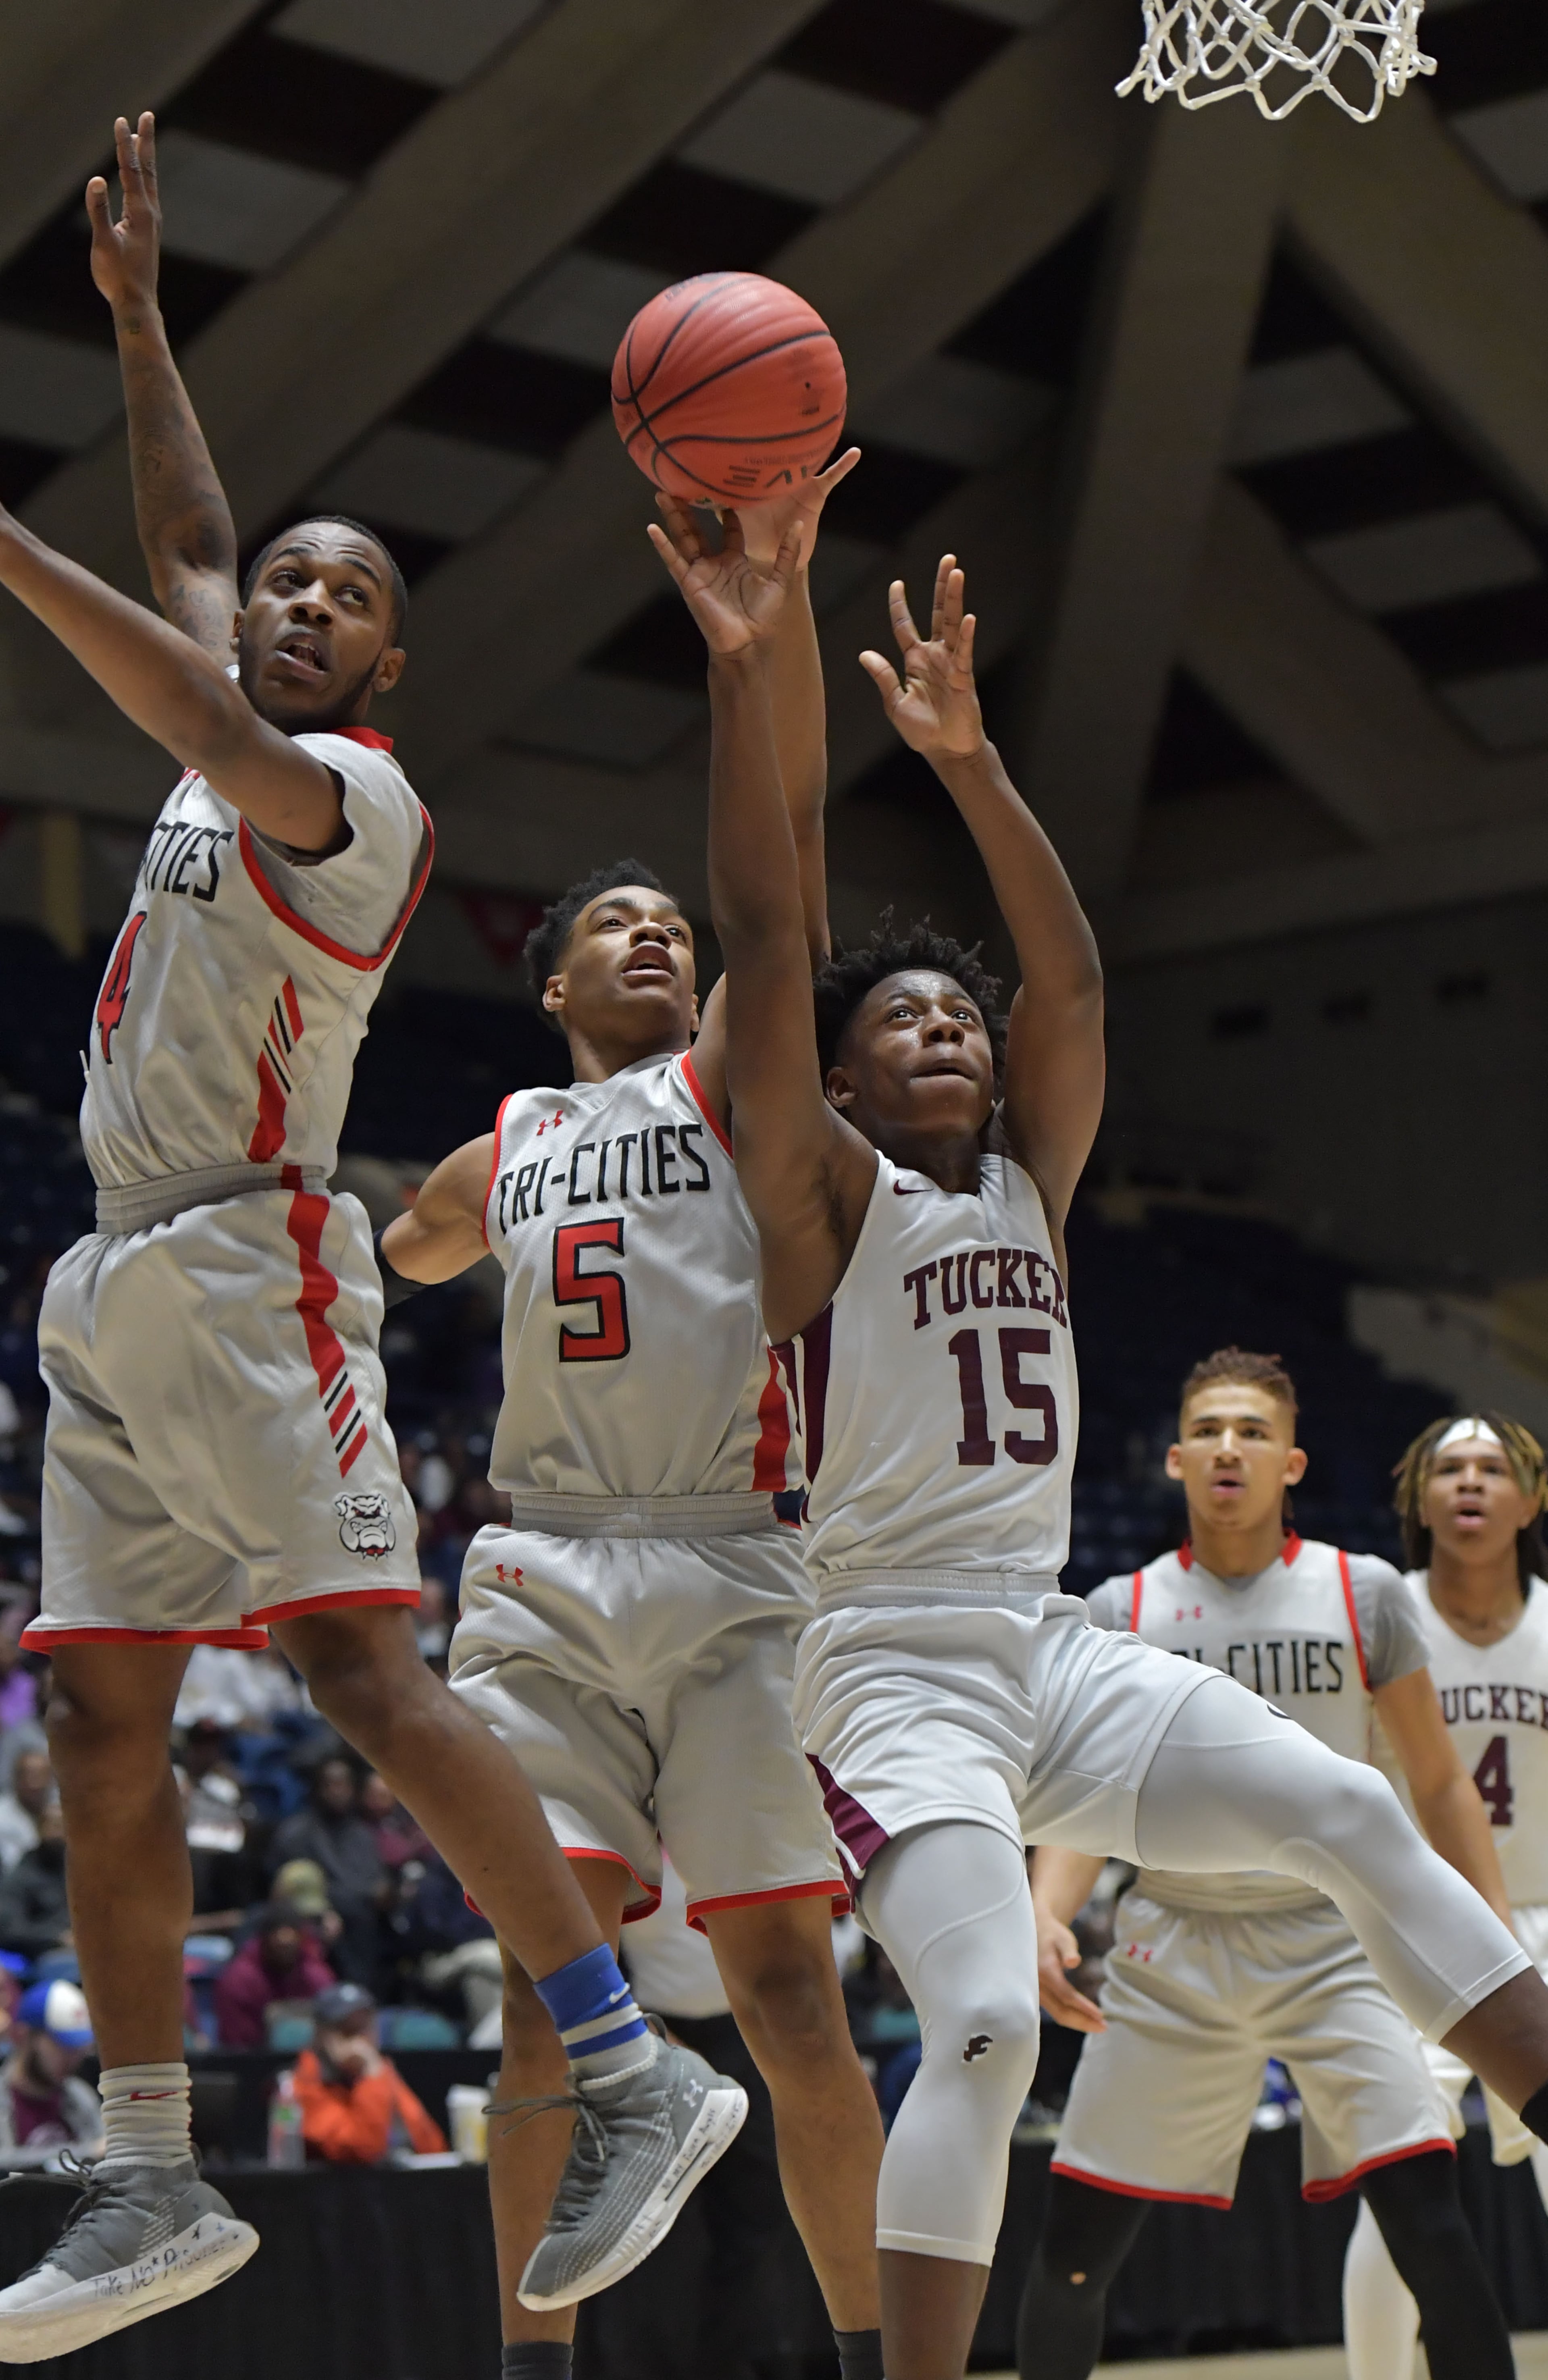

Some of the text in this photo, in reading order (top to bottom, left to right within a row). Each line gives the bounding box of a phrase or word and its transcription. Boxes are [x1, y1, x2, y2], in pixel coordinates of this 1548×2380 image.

[97, 911, 147, 1064] 4
[497, 1124, 710, 1235] TRI-CITIES
[552, 1217, 631, 1363] 5
[903, 1248, 1067, 1330] TUCKER
[948, 1328, 1058, 1465] 15
[1473, 1736, 1514, 1825] 4
